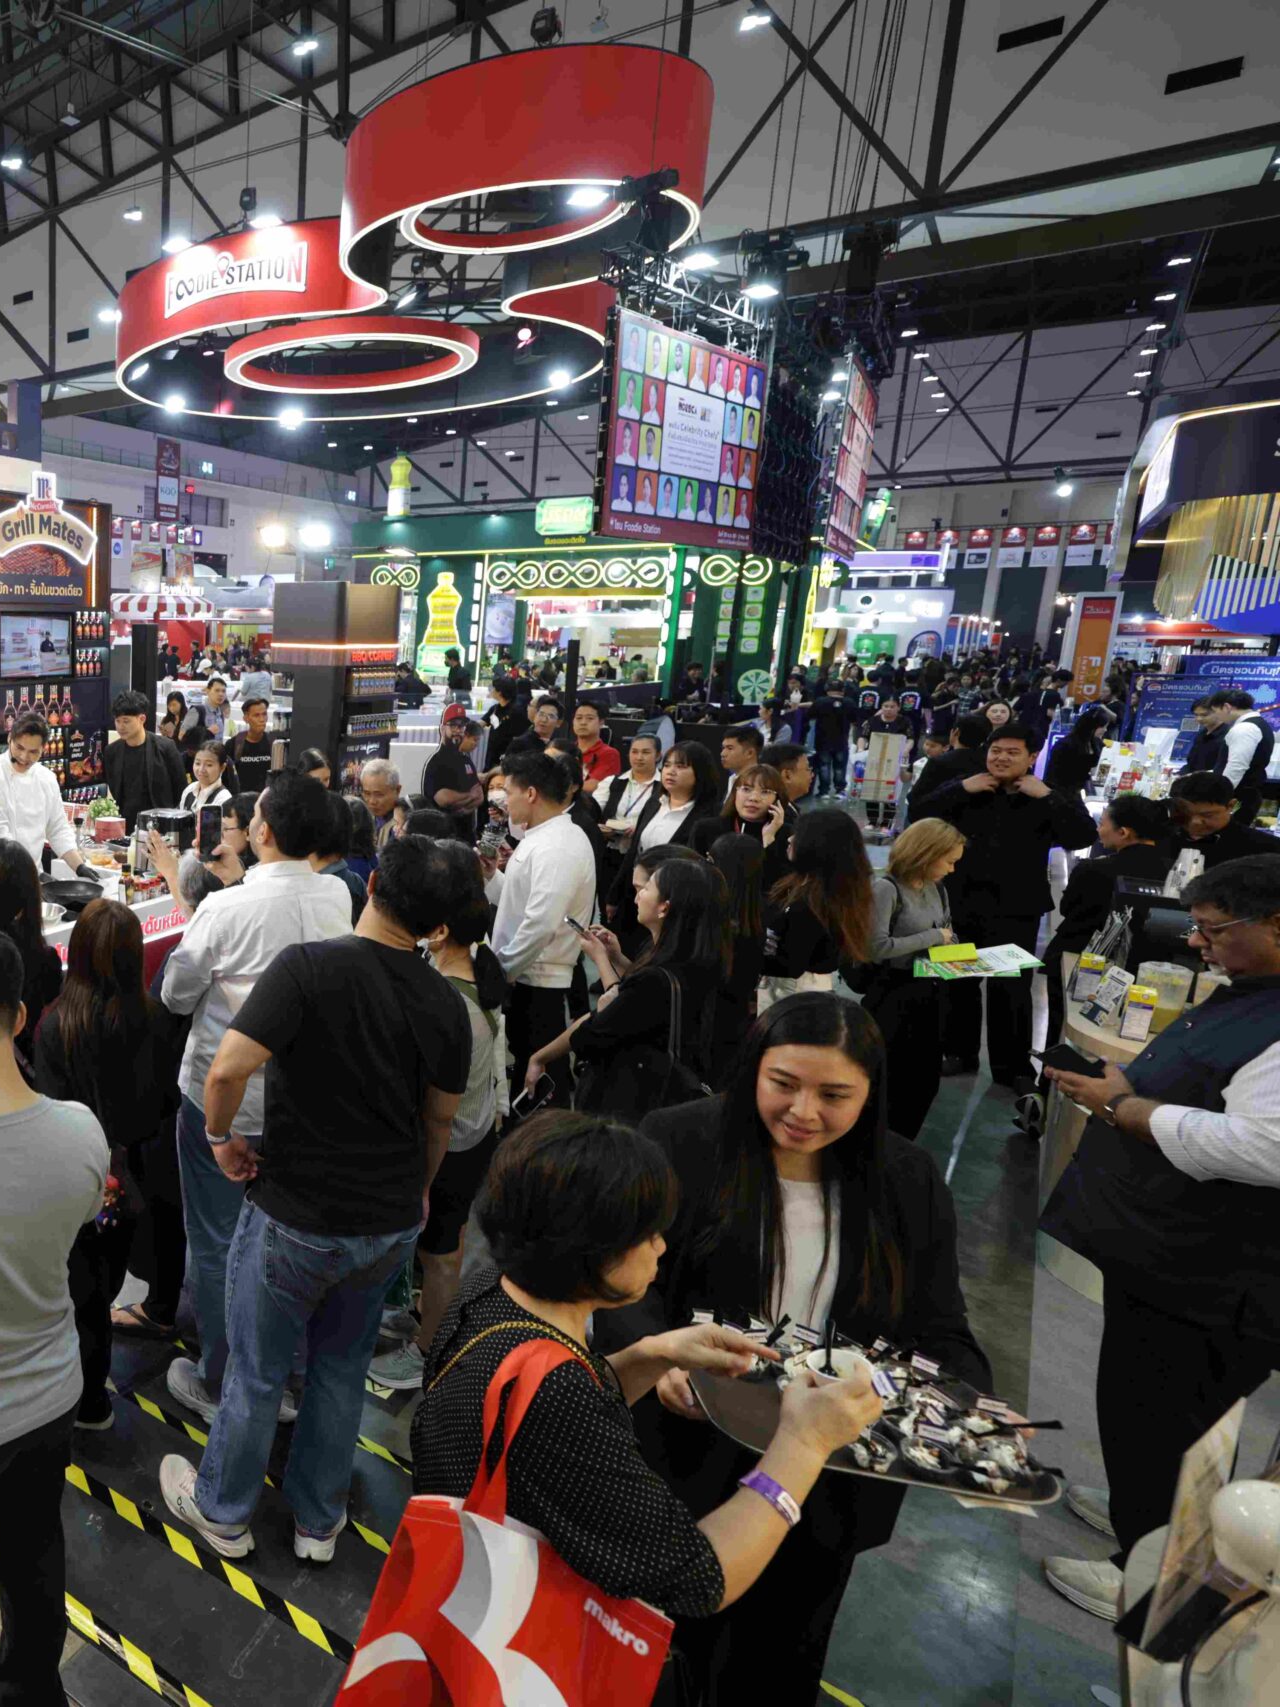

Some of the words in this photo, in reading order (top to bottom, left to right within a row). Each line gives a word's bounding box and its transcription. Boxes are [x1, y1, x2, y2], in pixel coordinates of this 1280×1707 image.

[225, 244, 302, 286] STATION
[1, 509, 34, 542] Grill
[39, 514, 84, 550] Mates
[352, 651, 367, 662] BBQ
[368, 650, 396, 661] CORNER
[583, 1597, 649, 1656] makro
